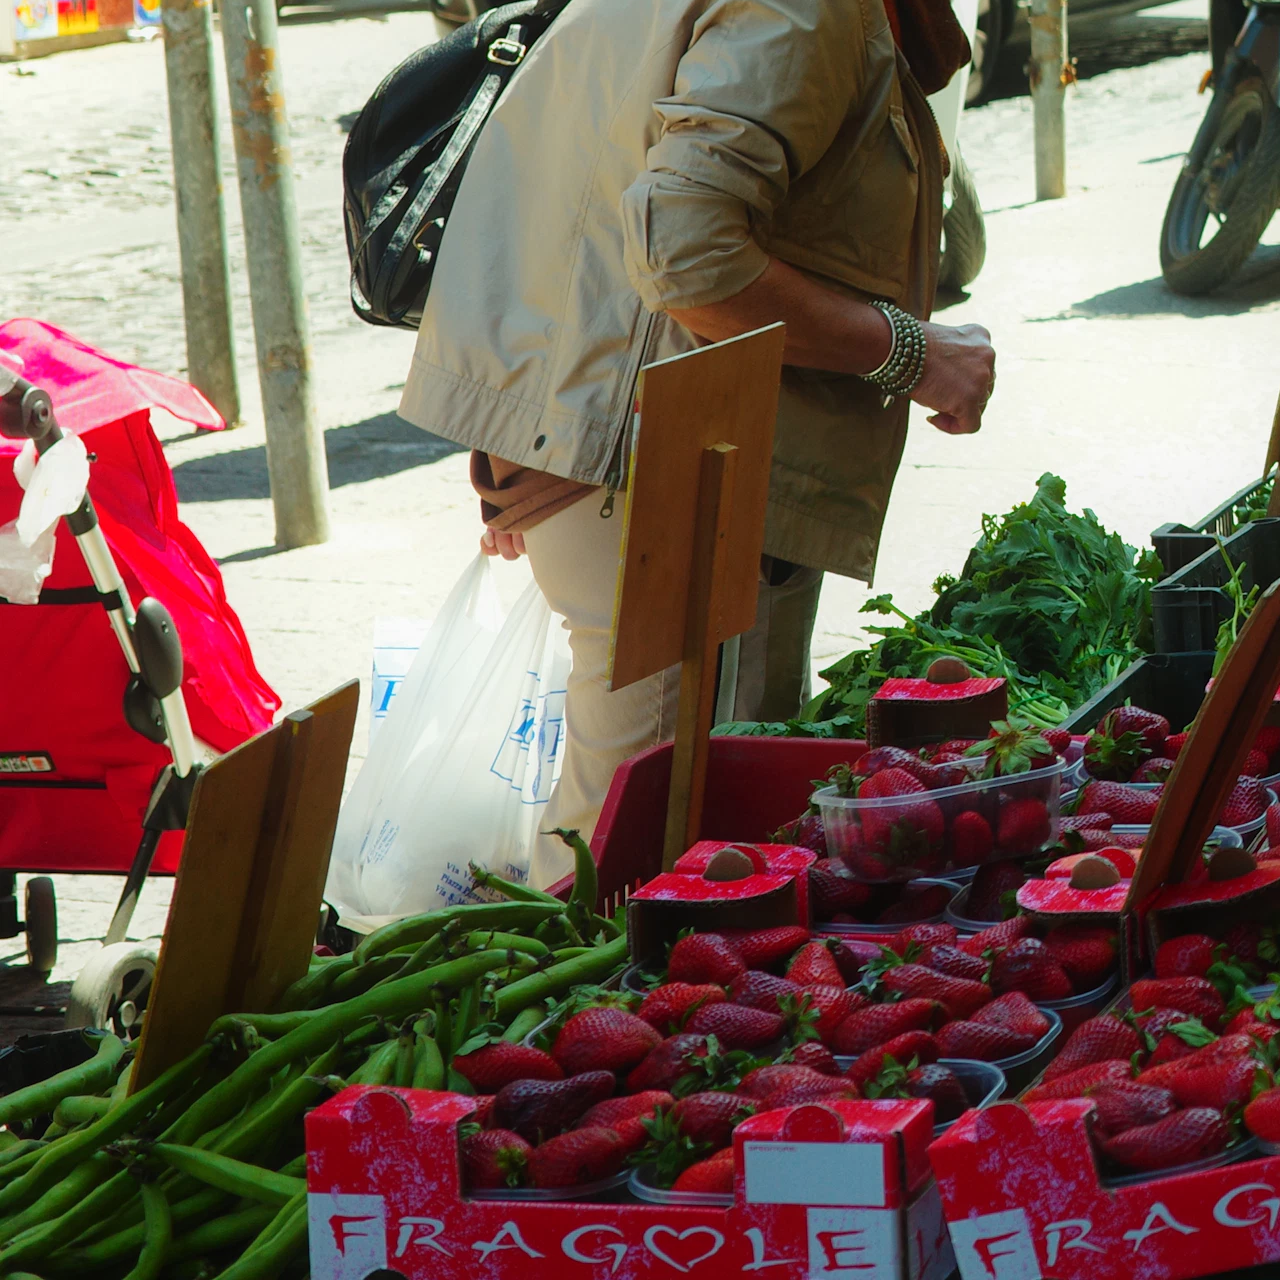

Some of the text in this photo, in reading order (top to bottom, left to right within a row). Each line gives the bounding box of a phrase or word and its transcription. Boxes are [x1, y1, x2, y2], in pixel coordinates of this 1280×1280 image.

[446, 861, 460, 875] Via
[440, 873, 463, 892] Piazza
[435, 885, 447, 897] Via
